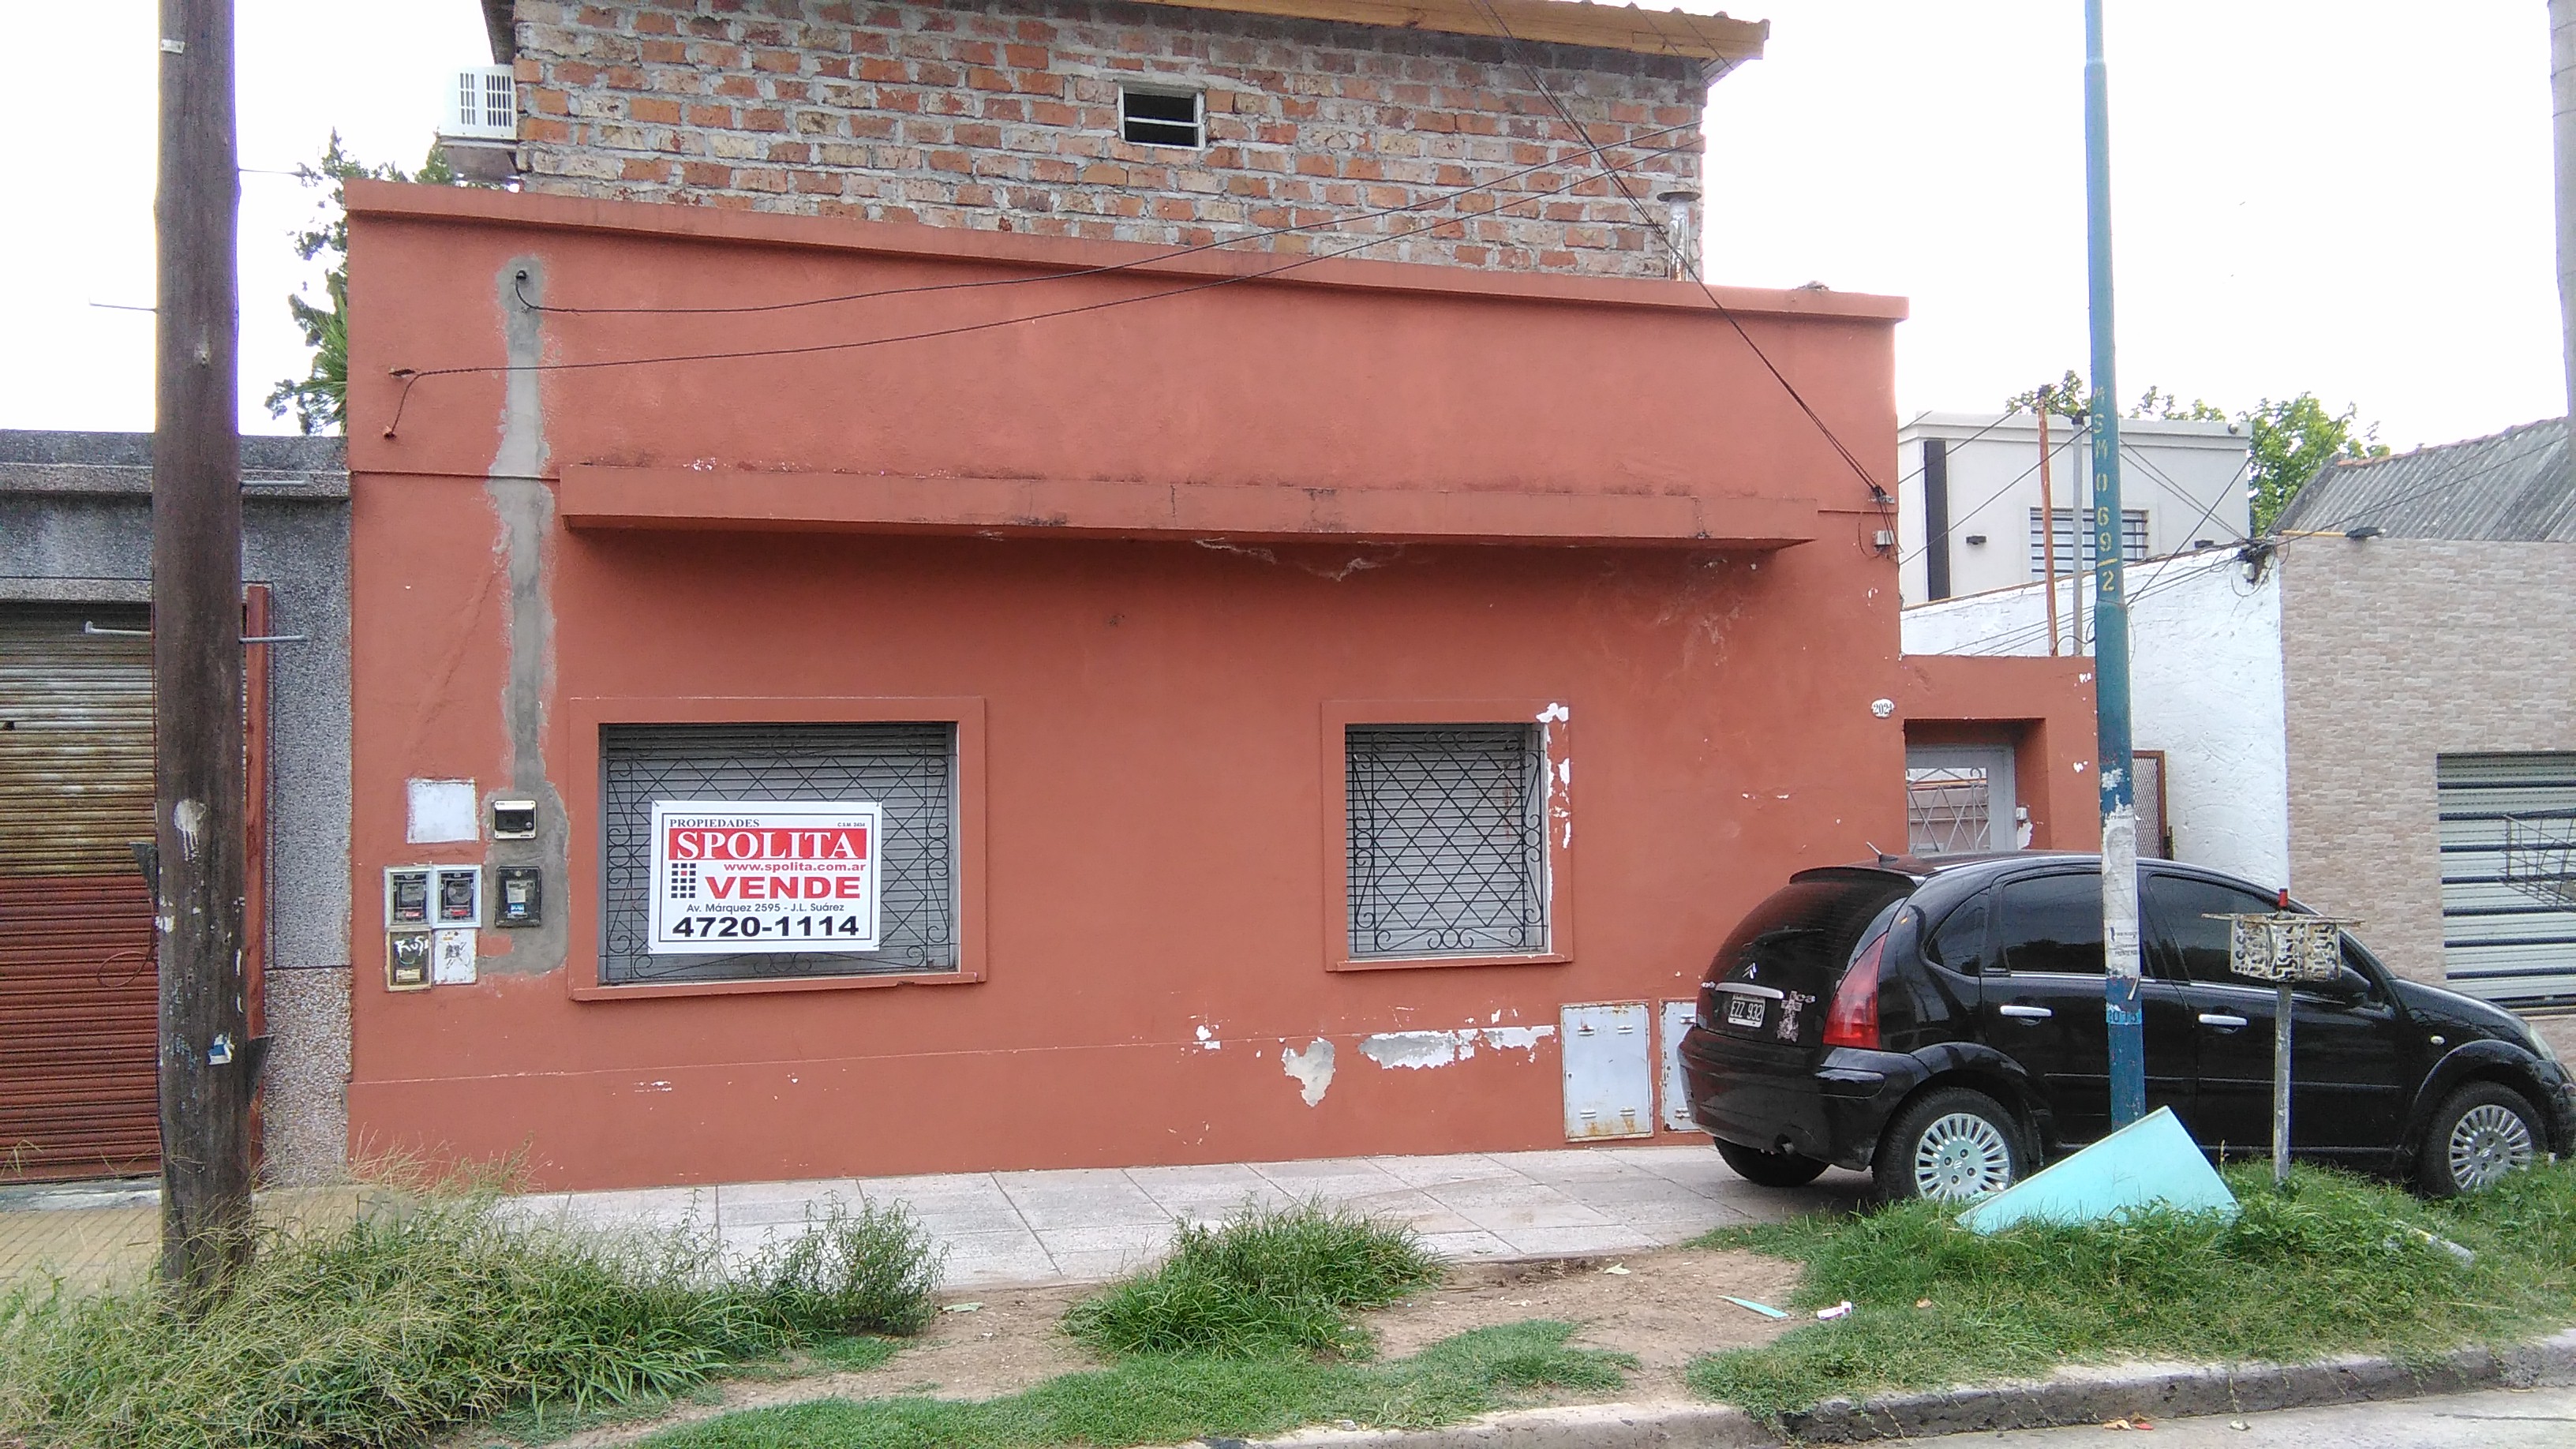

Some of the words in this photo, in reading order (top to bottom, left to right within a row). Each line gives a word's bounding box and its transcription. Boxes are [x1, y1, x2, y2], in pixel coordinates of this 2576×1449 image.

[669, 818, 760, 828] PROPIEDADES
[677, 831, 859, 859] SPOLITA
[724, 862, 867, 873] www.spolita.com.ar
[705, 876, 860, 899] VENDE
[686, 904, 702, 912] Av.
[706, 903, 752, 915] Márquez
[754, 903, 781, 912] 2595
[791, 903, 807, 912] J.L.
[810, 902, 844, 912] Suárez
[672, 915, 859, 938] 4720-1114
[1729, 1000, 1746, 1018] EZZ
[1747, 1003, 1763, 1021] 932
